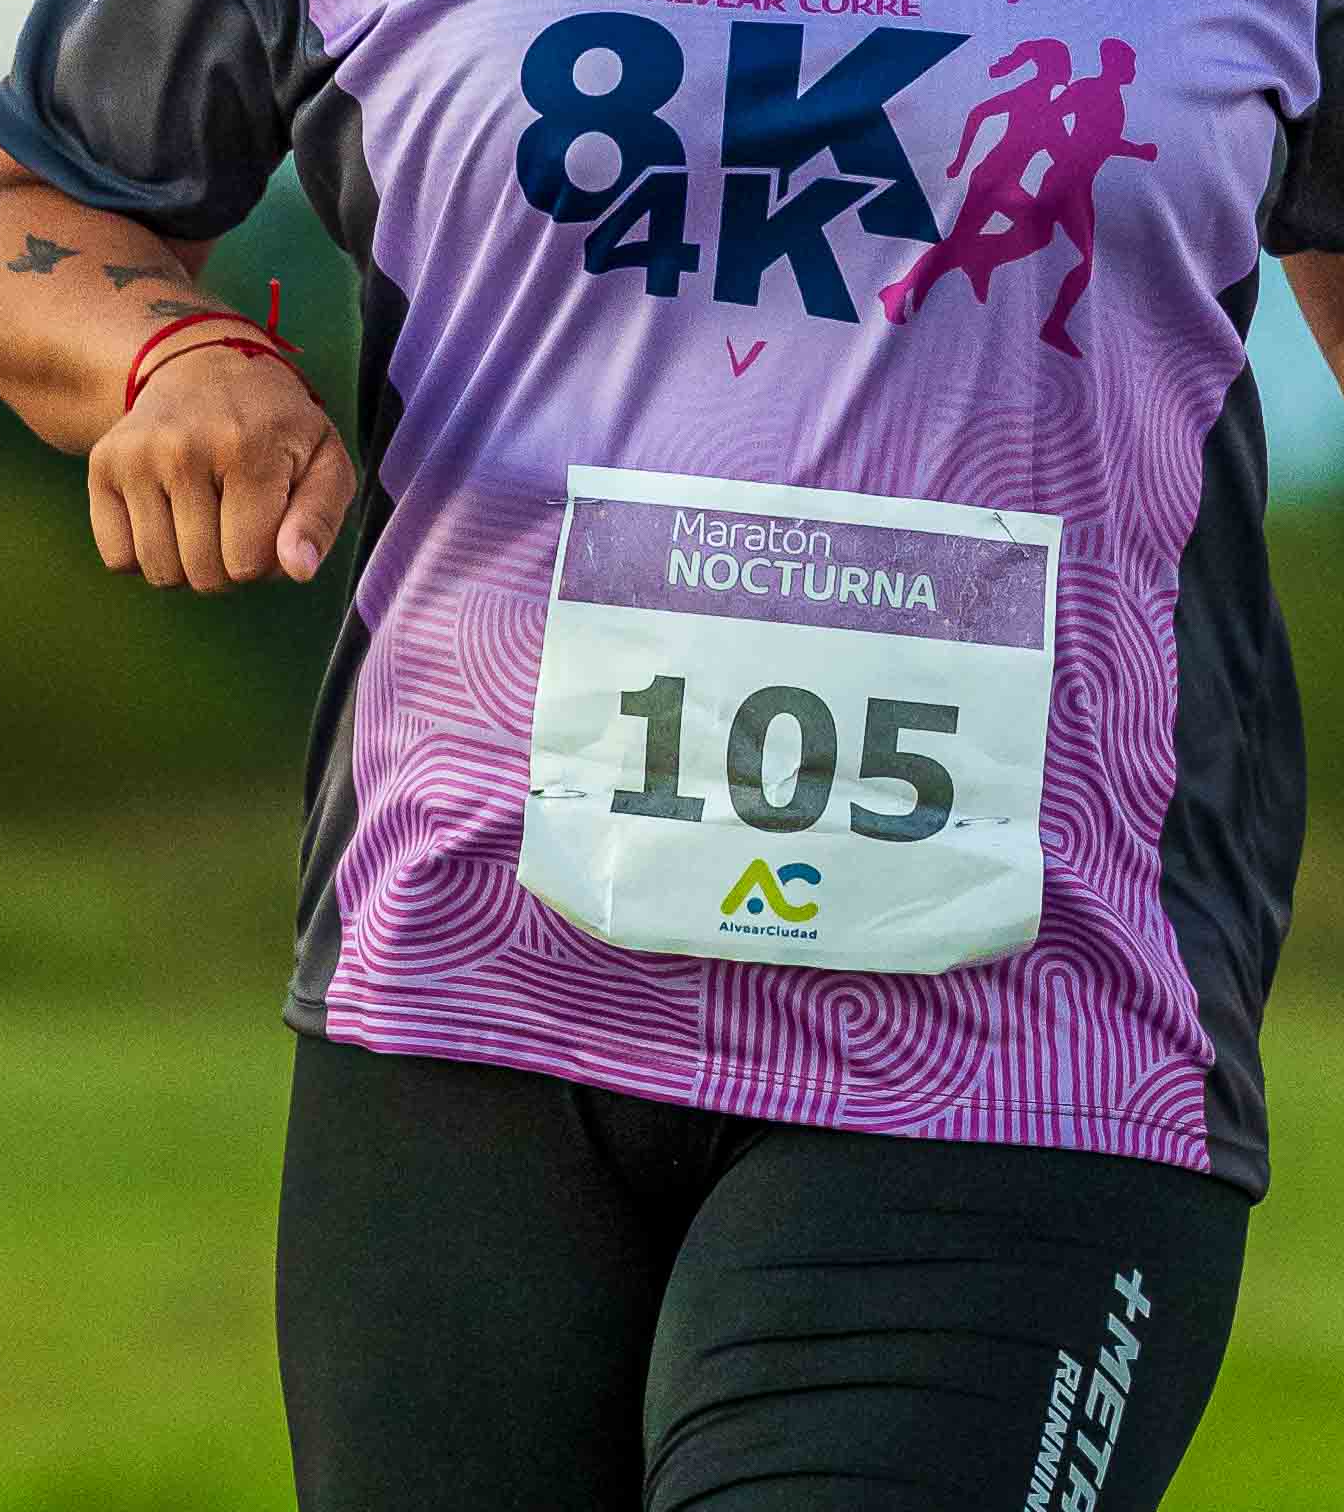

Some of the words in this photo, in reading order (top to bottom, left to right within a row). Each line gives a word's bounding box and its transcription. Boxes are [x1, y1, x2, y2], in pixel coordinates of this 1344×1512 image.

[515, 10, 974, 244] 8K
[584, 171, 860, 325] 4K
[667, 549, 937, 611] NOCTURNA
[672, 510, 832, 558] Maratón
[610, 674, 960, 843] 105
[719, 921, 817, 939] AlvearCiudad
